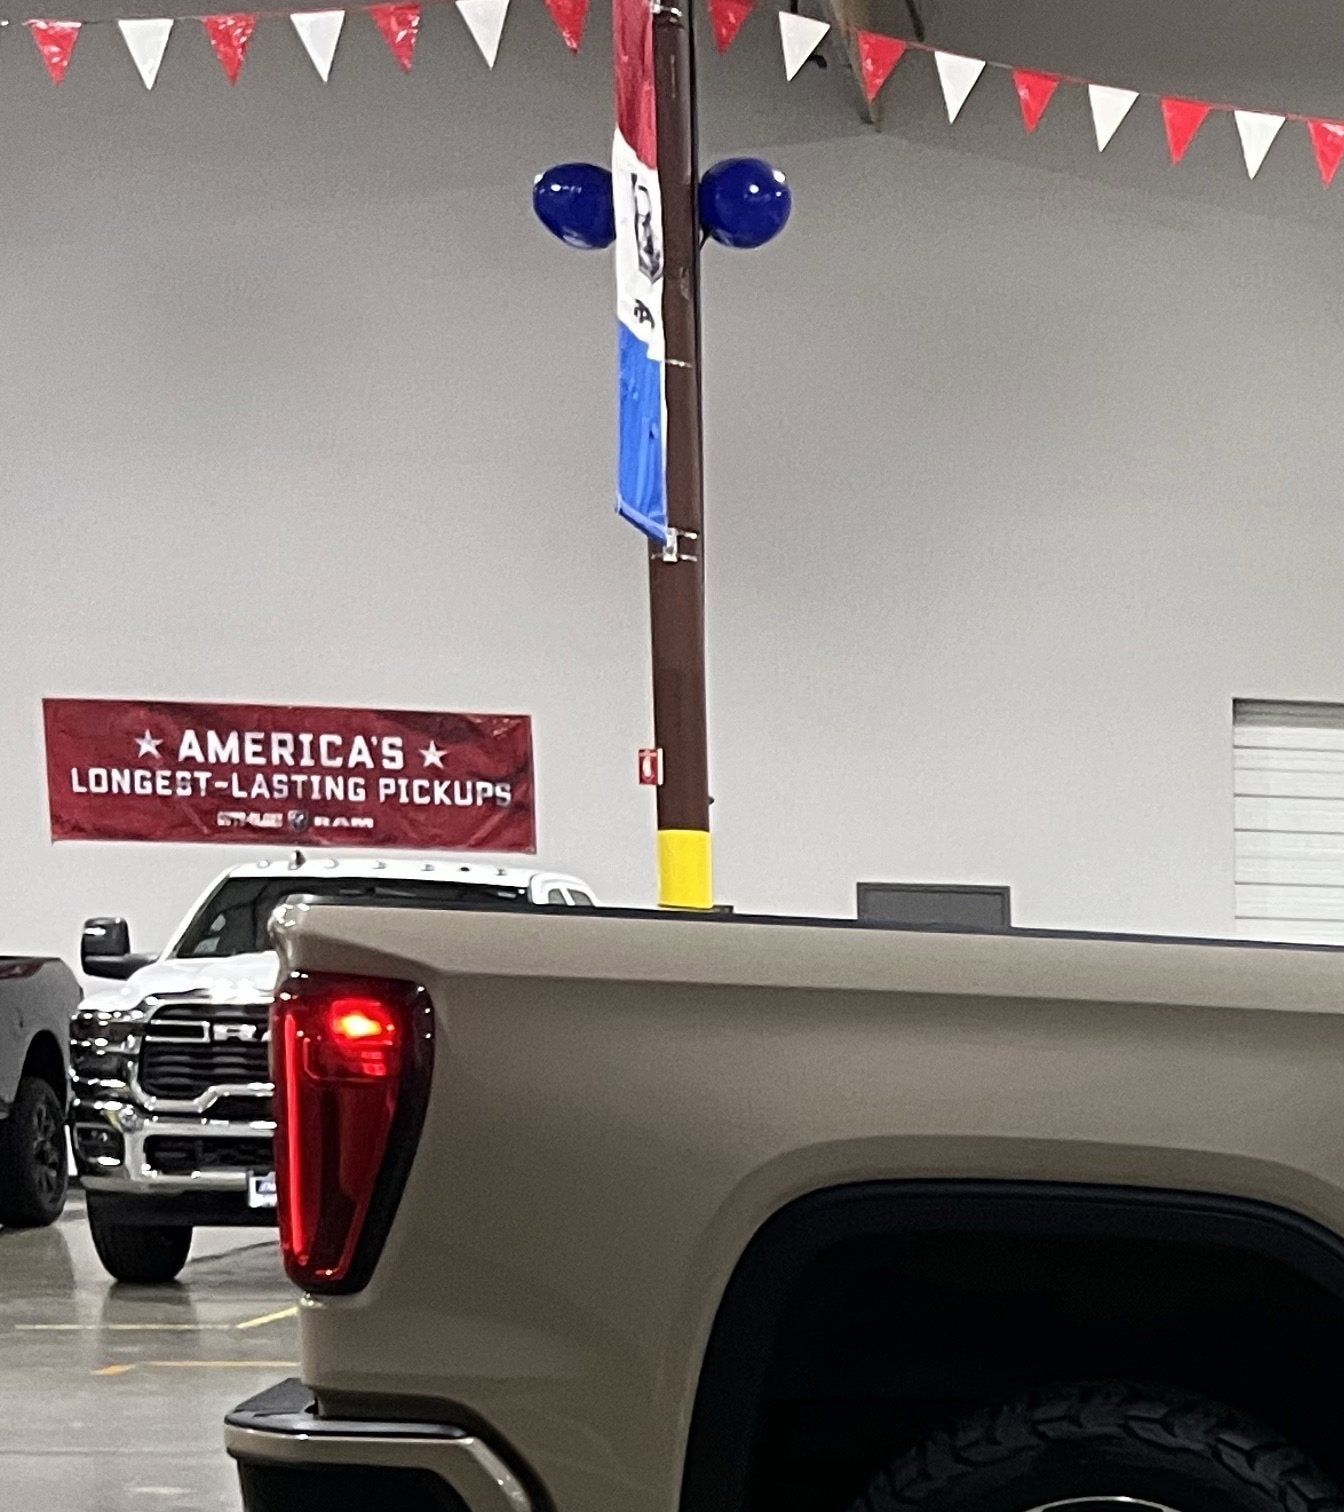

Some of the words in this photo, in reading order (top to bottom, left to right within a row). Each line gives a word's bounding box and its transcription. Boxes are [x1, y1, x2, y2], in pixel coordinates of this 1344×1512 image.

[178, 729, 403, 769] AMERICA'S
[71, 767, 366, 801] LONGEST-LASTING
[379, 776, 512, 807] PICKUPS
[314, 815, 374, 829] RAM
